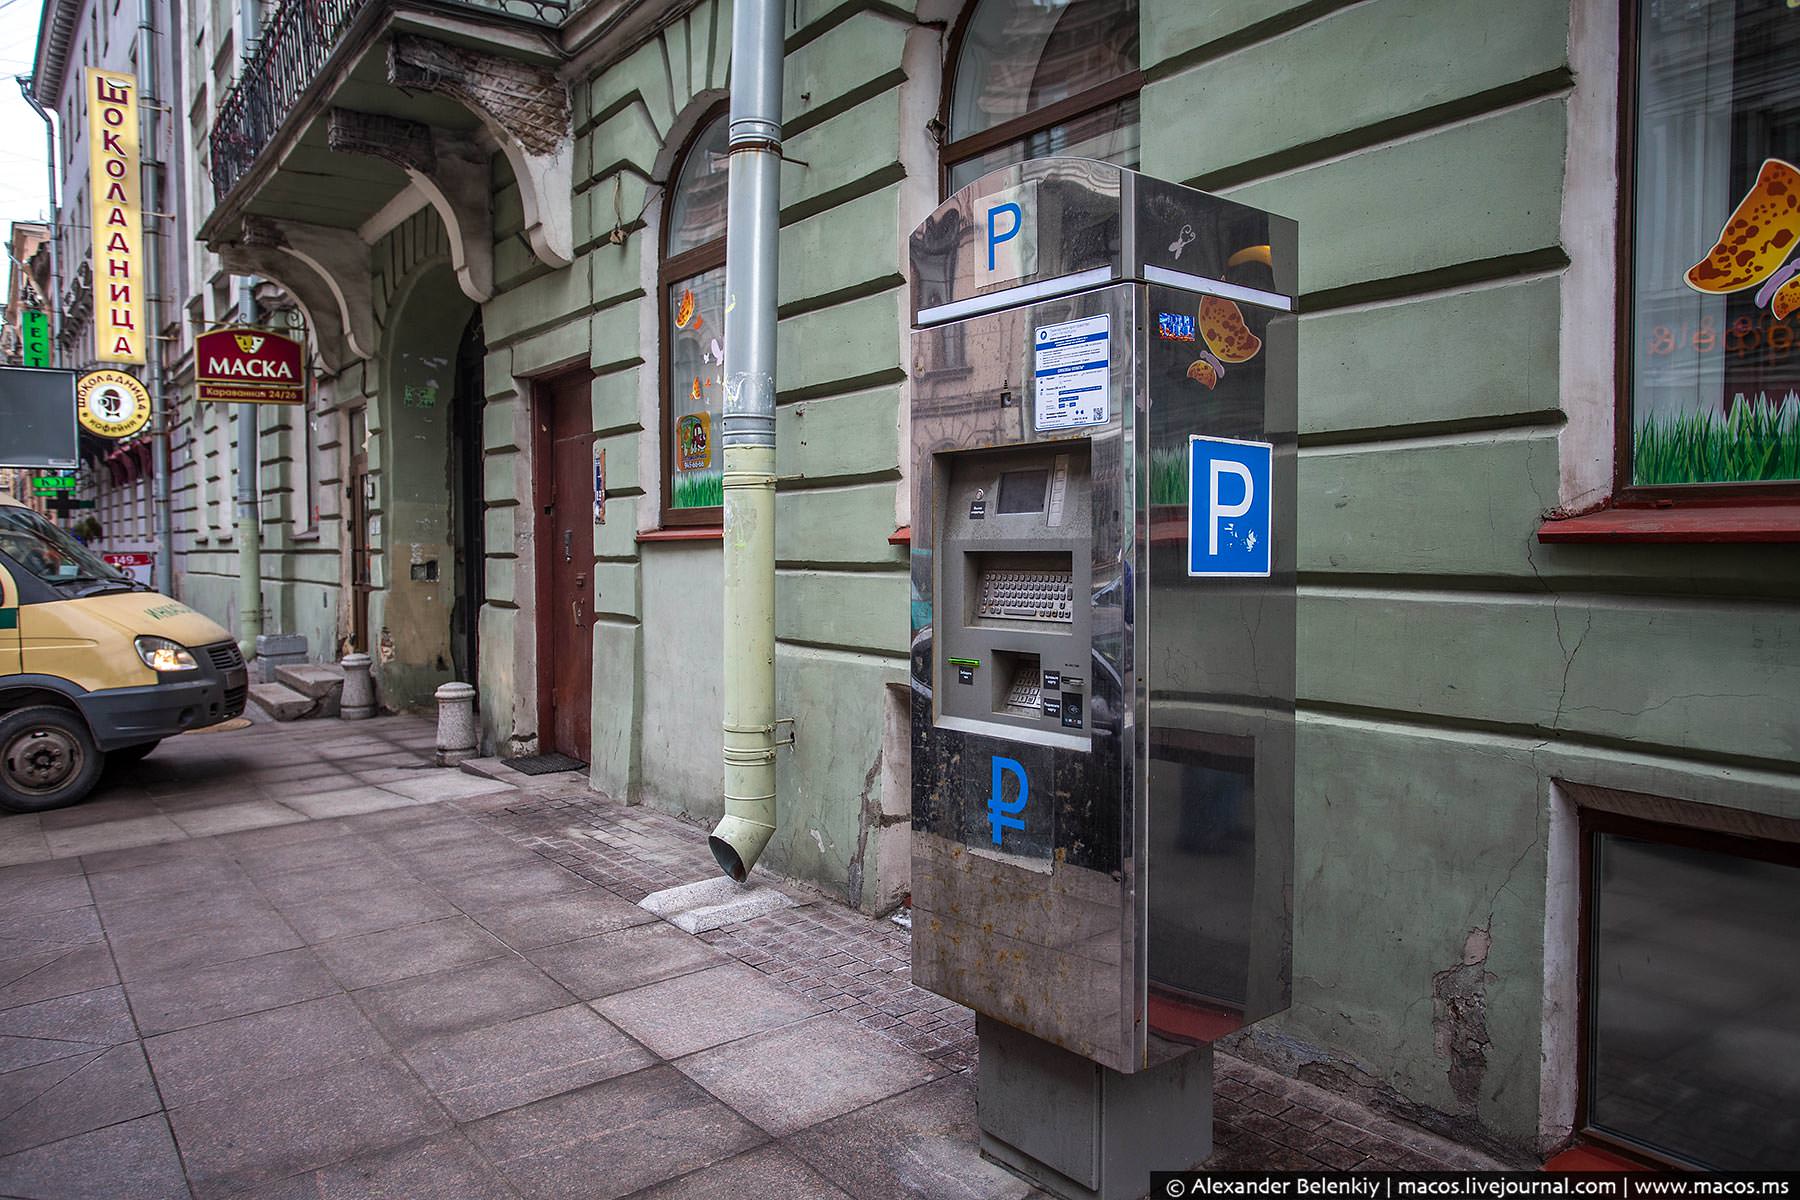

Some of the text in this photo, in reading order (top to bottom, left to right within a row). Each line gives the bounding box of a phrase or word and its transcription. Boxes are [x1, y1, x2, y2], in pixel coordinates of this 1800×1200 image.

[97, 76, 135, 355] ШОКОЛАДНИЦА
[988, 202, 1022, 271] P
[78, 374, 147, 410] ШОКОЛАДНИЦА
[206, 387, 297, 399] Караванная 24/26
[208, 356, 293, 379] МАСКА
[1209, 459, 1254, 555] P
